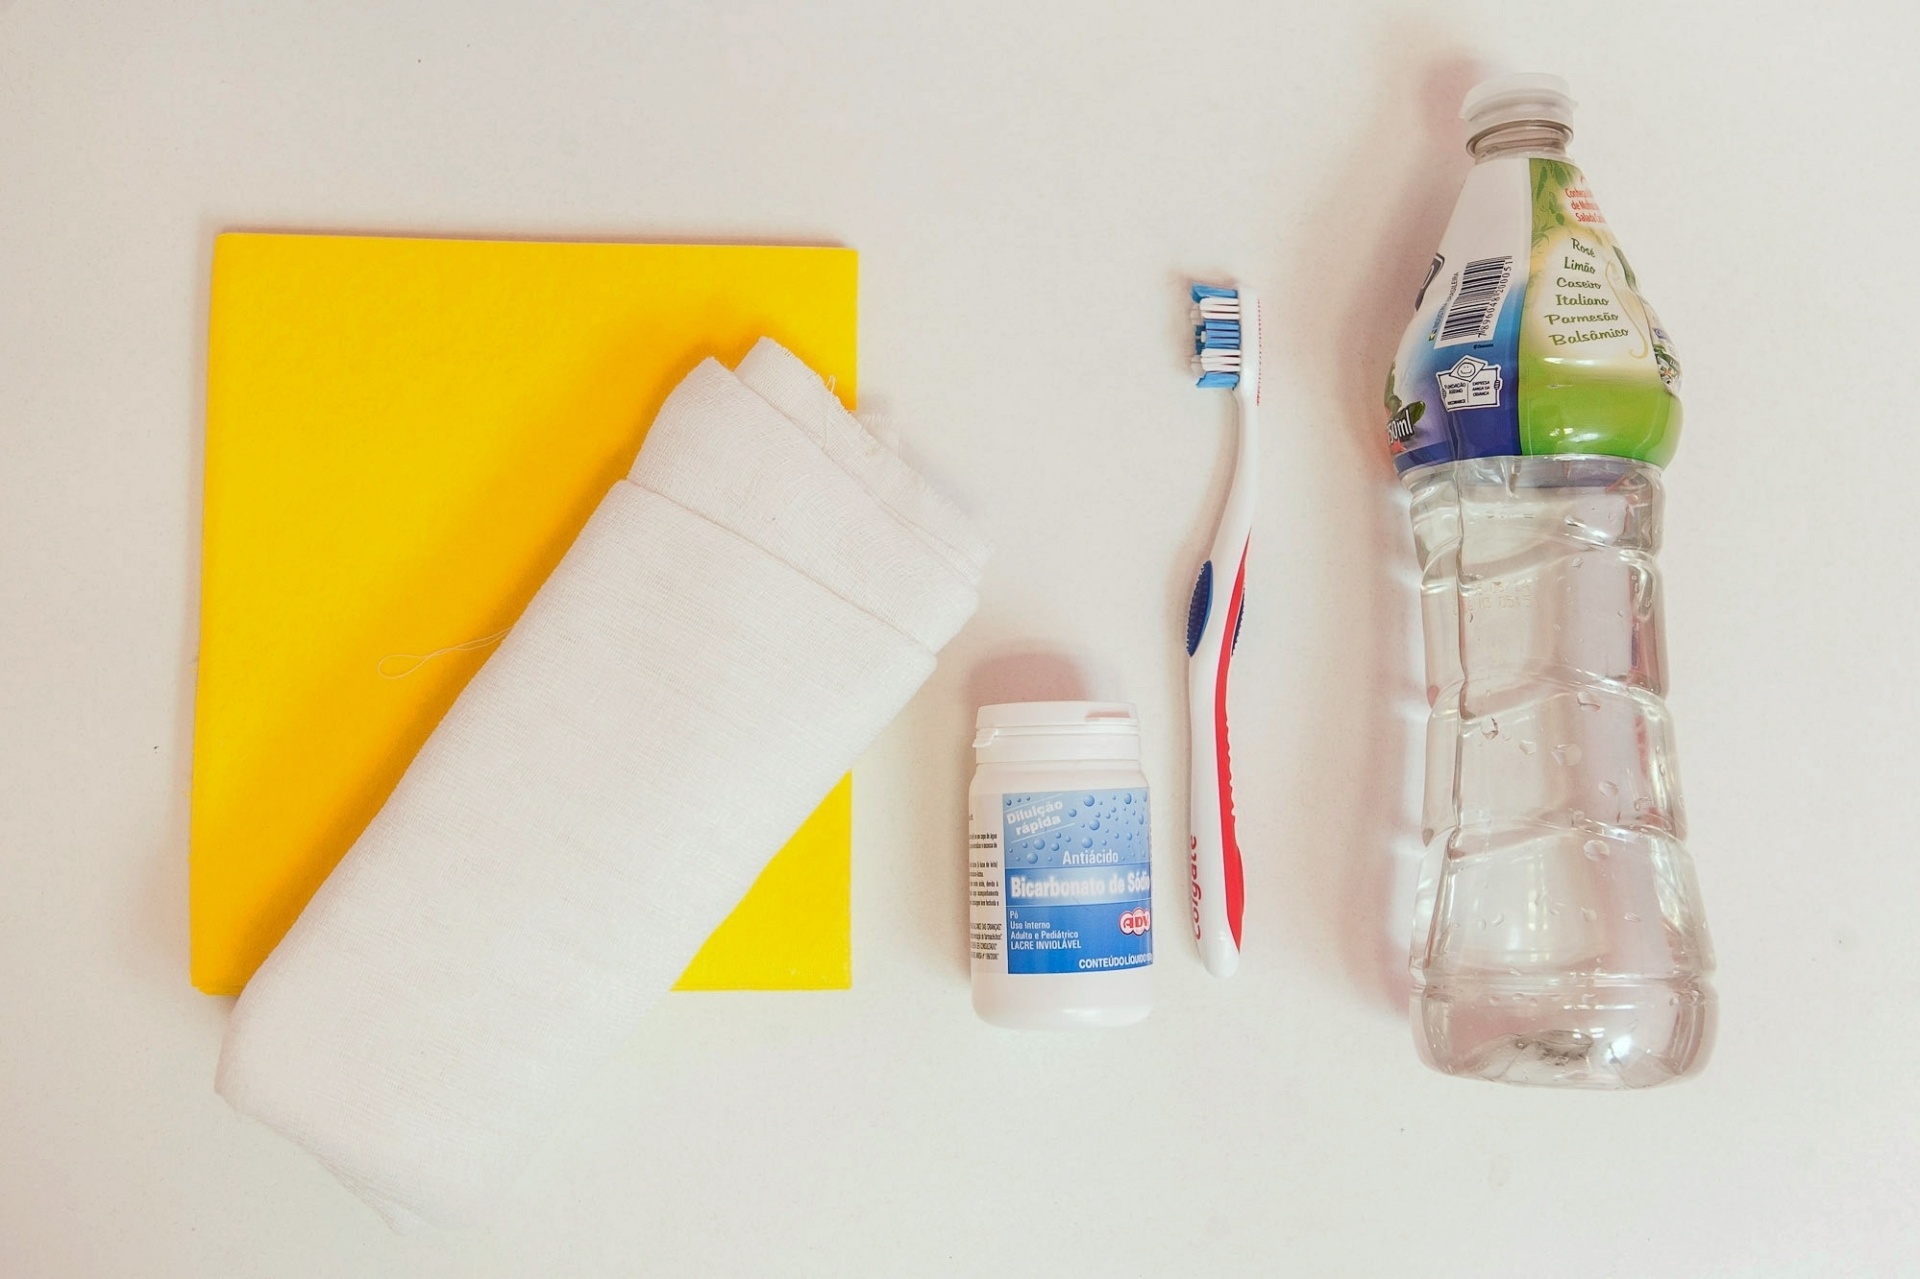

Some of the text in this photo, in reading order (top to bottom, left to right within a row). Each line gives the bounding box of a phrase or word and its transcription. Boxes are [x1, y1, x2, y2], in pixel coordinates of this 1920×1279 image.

[1570, 237, 1596, 258] Rosé
[1563, 256, 1596, 275] Limão
[1556, 276, 1602, 290] Caseiro
[1555, 293, 1610, 306] Italiano
[1543, 312, 1619, 326] Parmesão
[1548, 327, 1630, 346] Balsâmico
[1387, 409, 1414, 445] 50ml
[1006, 800, 1063, 825] Diluição
[1016, 815, 1061, 836] rápida
[1062, 850, 1119, 866] Antiácido
[1010, 874, 1105, 898] Bicarbonato
[1109, 874, 1125, 895] de
[1010, 910, 1019, 919] Pó
[1010, 920, 1051, 930] Uso Interno
[1010, 930, 1033, 940] Adulto
[1034, 932, 1040, 940] e
[1040, 930, 1079, 940] Pediátrico
[1010, 940, 1034, 950] LACRE
[1035, 938, 1082, 950] INVIOLÁVEL
